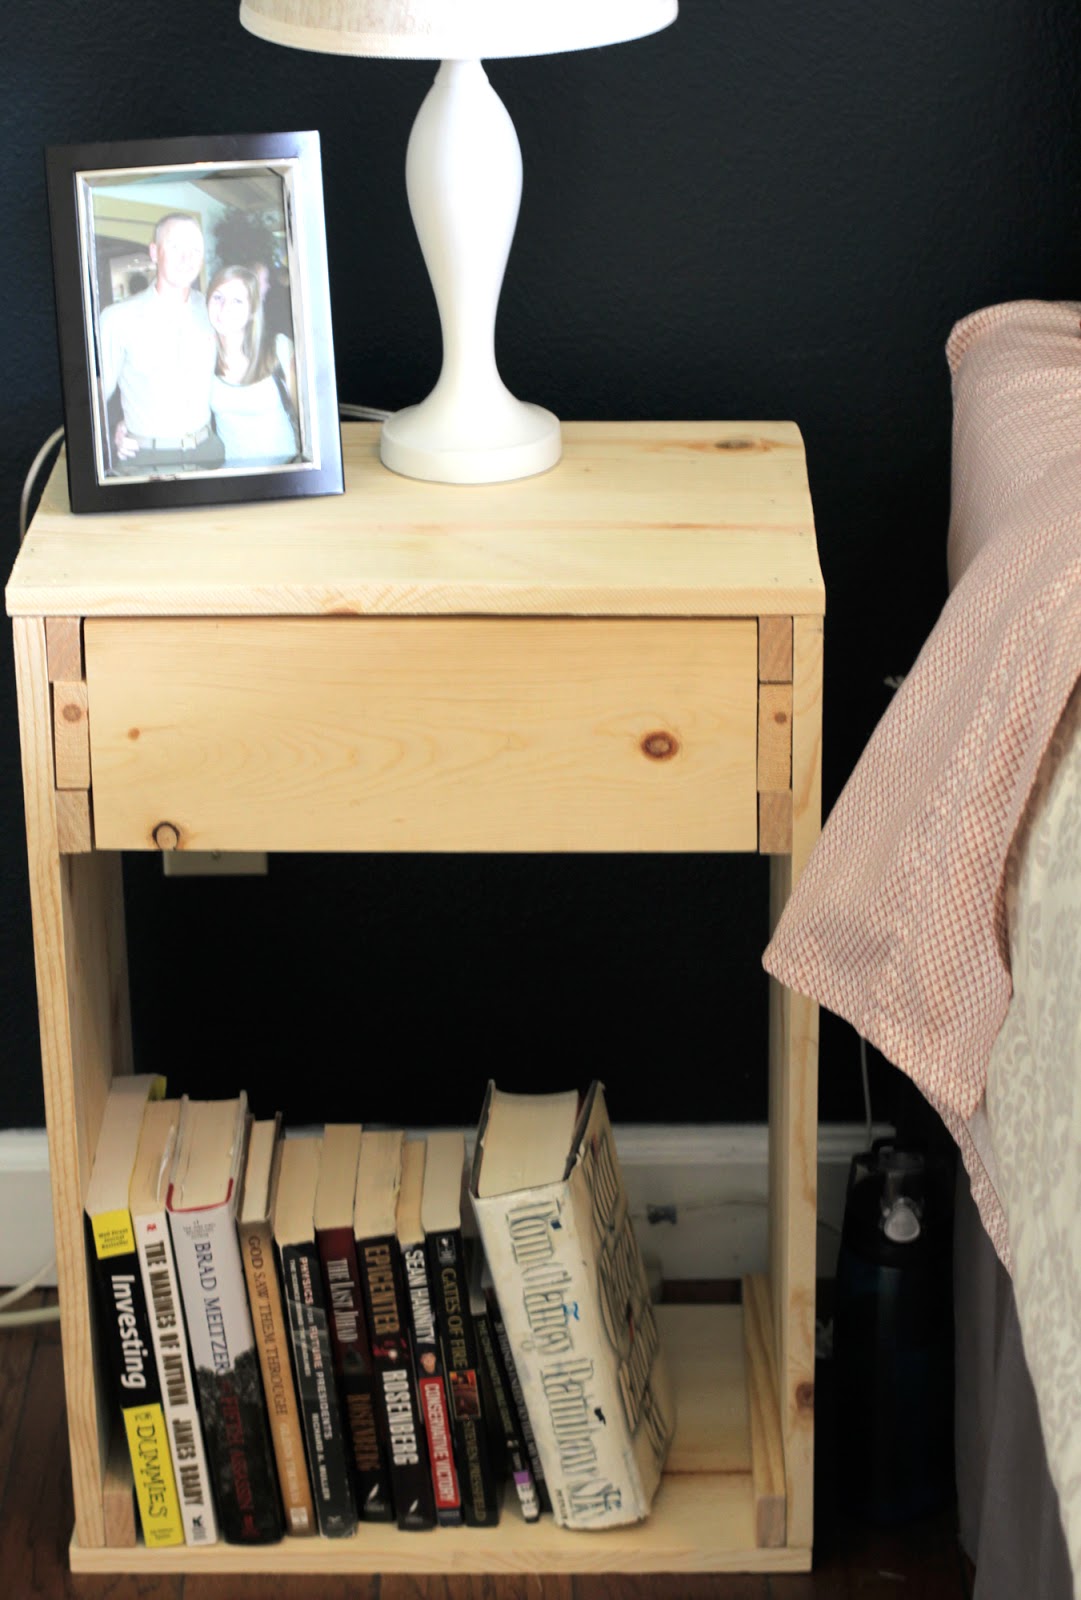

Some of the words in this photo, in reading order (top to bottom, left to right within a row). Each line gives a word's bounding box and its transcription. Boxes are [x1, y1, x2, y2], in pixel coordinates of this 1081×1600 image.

[145, 1240, 168, 1268] THE
[248, 1235, 265, 1269] GOD
[505, 1198, 562, 1264] Tom
[194, 1241, 218, 1291] BRAD
[252, 1269, 269, 1301] SAW
[299, 1256, 314, 1306] PHYSICS
[327, 1258, 349, 1279] THE
[364, 1244, 400, 1336] EPICENTER
[405, 1249, 426, 1286] SEAN
[441, 1267, 461, 1315] GATES
[149, 1269, 176, 1330] MARINES
[257, 1301, 276, 1347] THEM
[410, 1287, 436, 1345] HANNITY
[447, 1315, 464, 1336] OF
[521, 1262, 575, 1354] Clancy
[111, 1274, 147, 1389] Investing
[159, 1332, 180, 1350] OF
[203, 1296, 233, 1375] MELTZER
[308, 1325, 323, 1370] FUTURE
[450, 1338, 468, 1368] FIRE
[162, 1353, 190, 1407] AUTUMN
[263, 1347, 289, 1417] THROUGH
[315, 1371, 334, 1441] PRESIDENTS
[172, 1418, 197, 1460] JAMES
[346, 1393, 381, 1472] ROSENBERG
[382, 1369, 419, 1466] ROSENBERG
[423, 1383, 451, 1460] CONSERVATIVE
[463, 1420, 479, 1461] STEVEN
[539, 1359, 605, 1478] Rainbow
[136, 1424, 168, 1519] DUMMIES
[311, 1413, 324, 1452] RICHARD
[319, 1465, 330, 1501] MULLER
[433, 1460, 456, 1503] VICTORY
[180, 1464, 205, 1506] BRADY
[467, 1462, 487, 1522] PRESSFIELD
